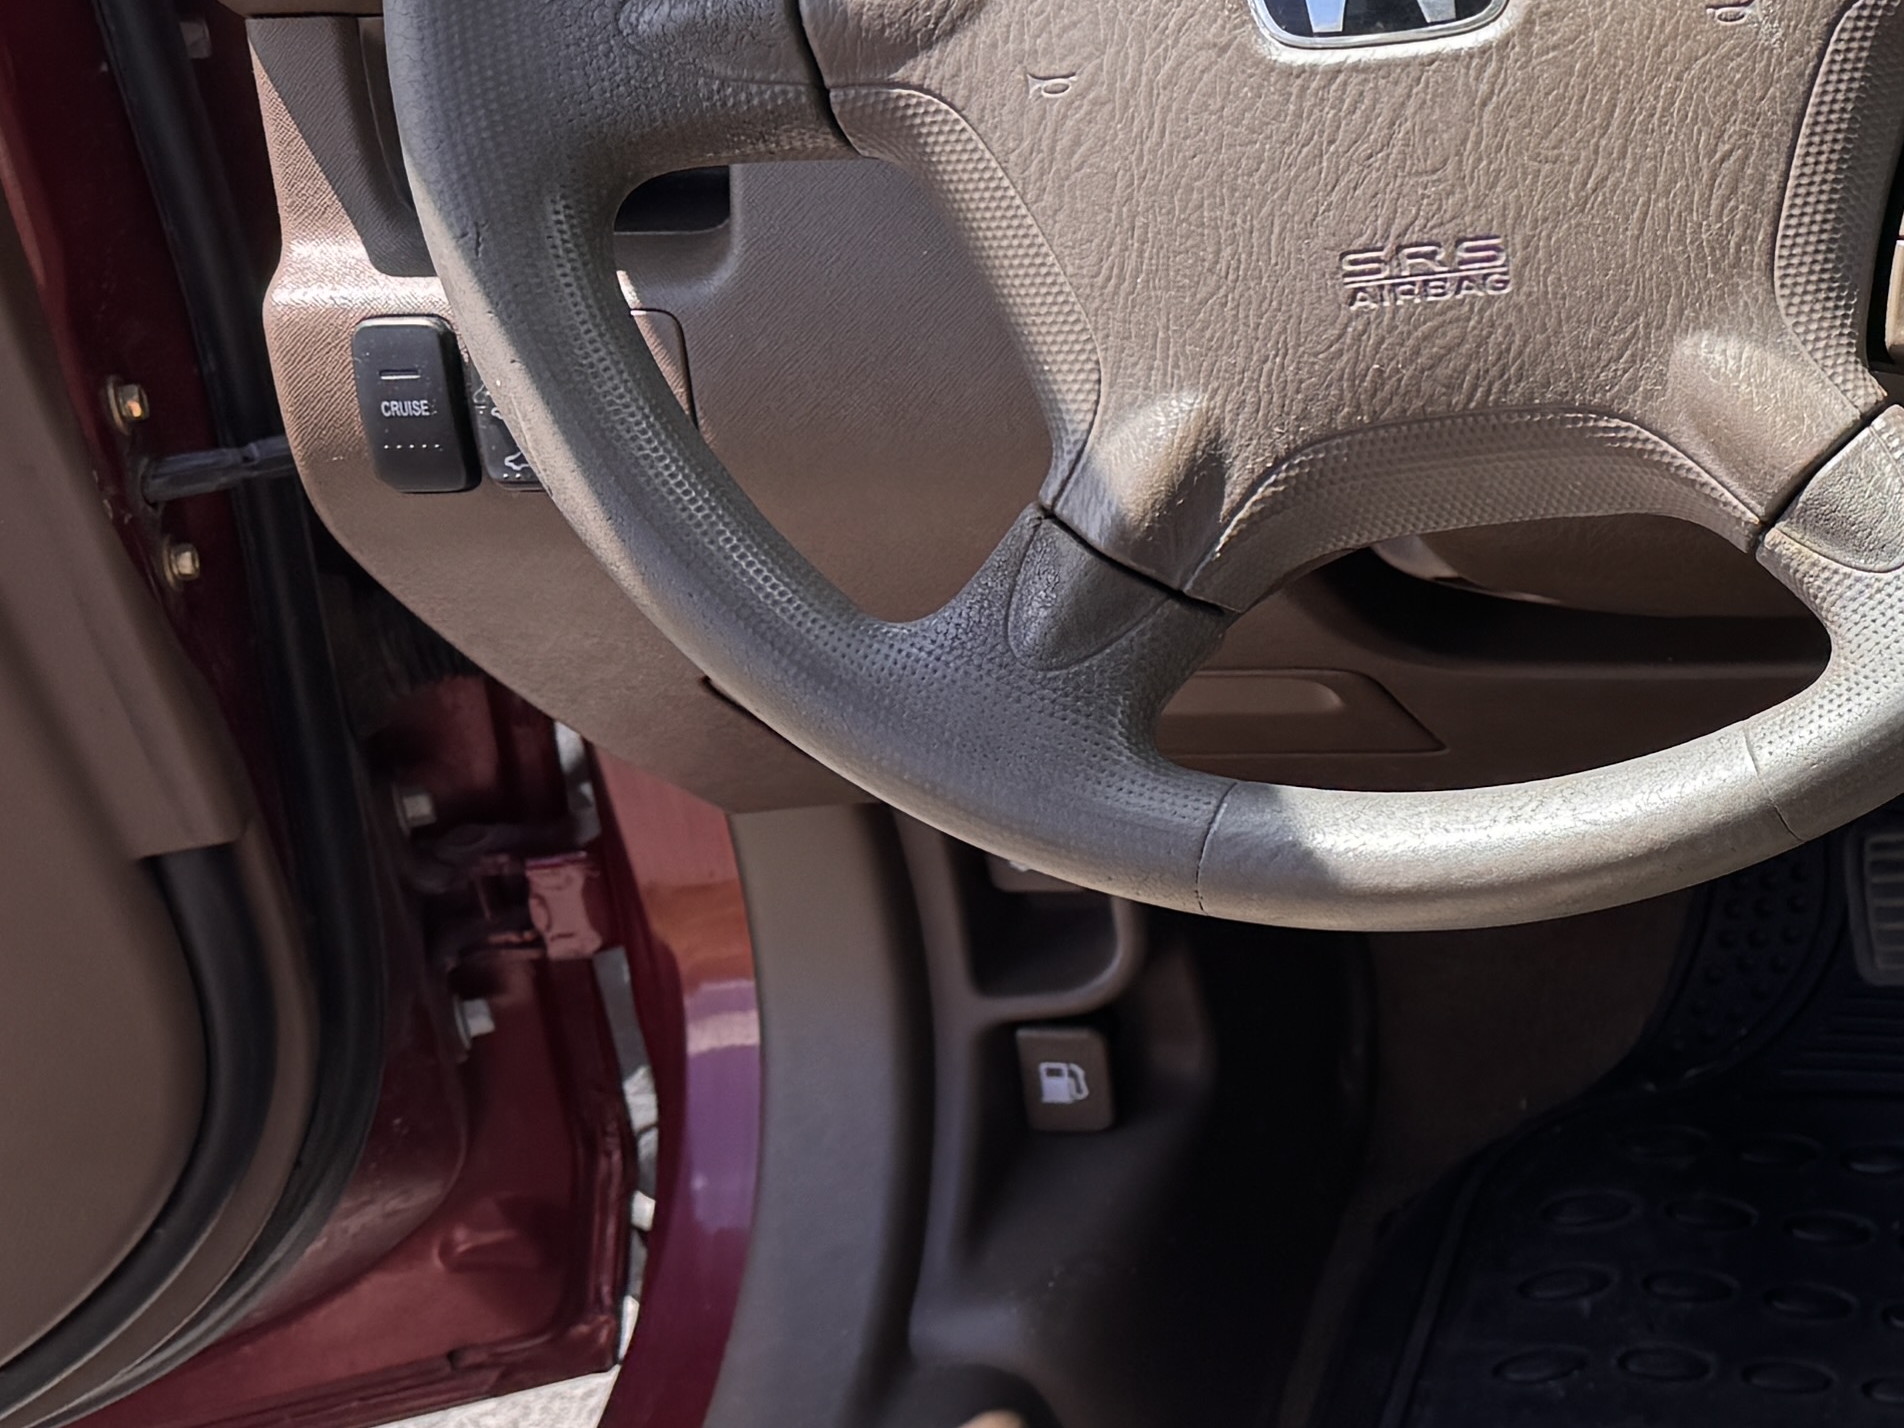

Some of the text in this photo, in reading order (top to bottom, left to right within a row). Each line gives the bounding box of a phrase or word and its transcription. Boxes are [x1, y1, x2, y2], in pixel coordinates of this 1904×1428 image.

[1339, 236, 1507, 283] SRS
[1349, 273, 1513, 312] AIRBAG
[381, 401, 430, 417] CRUISE
